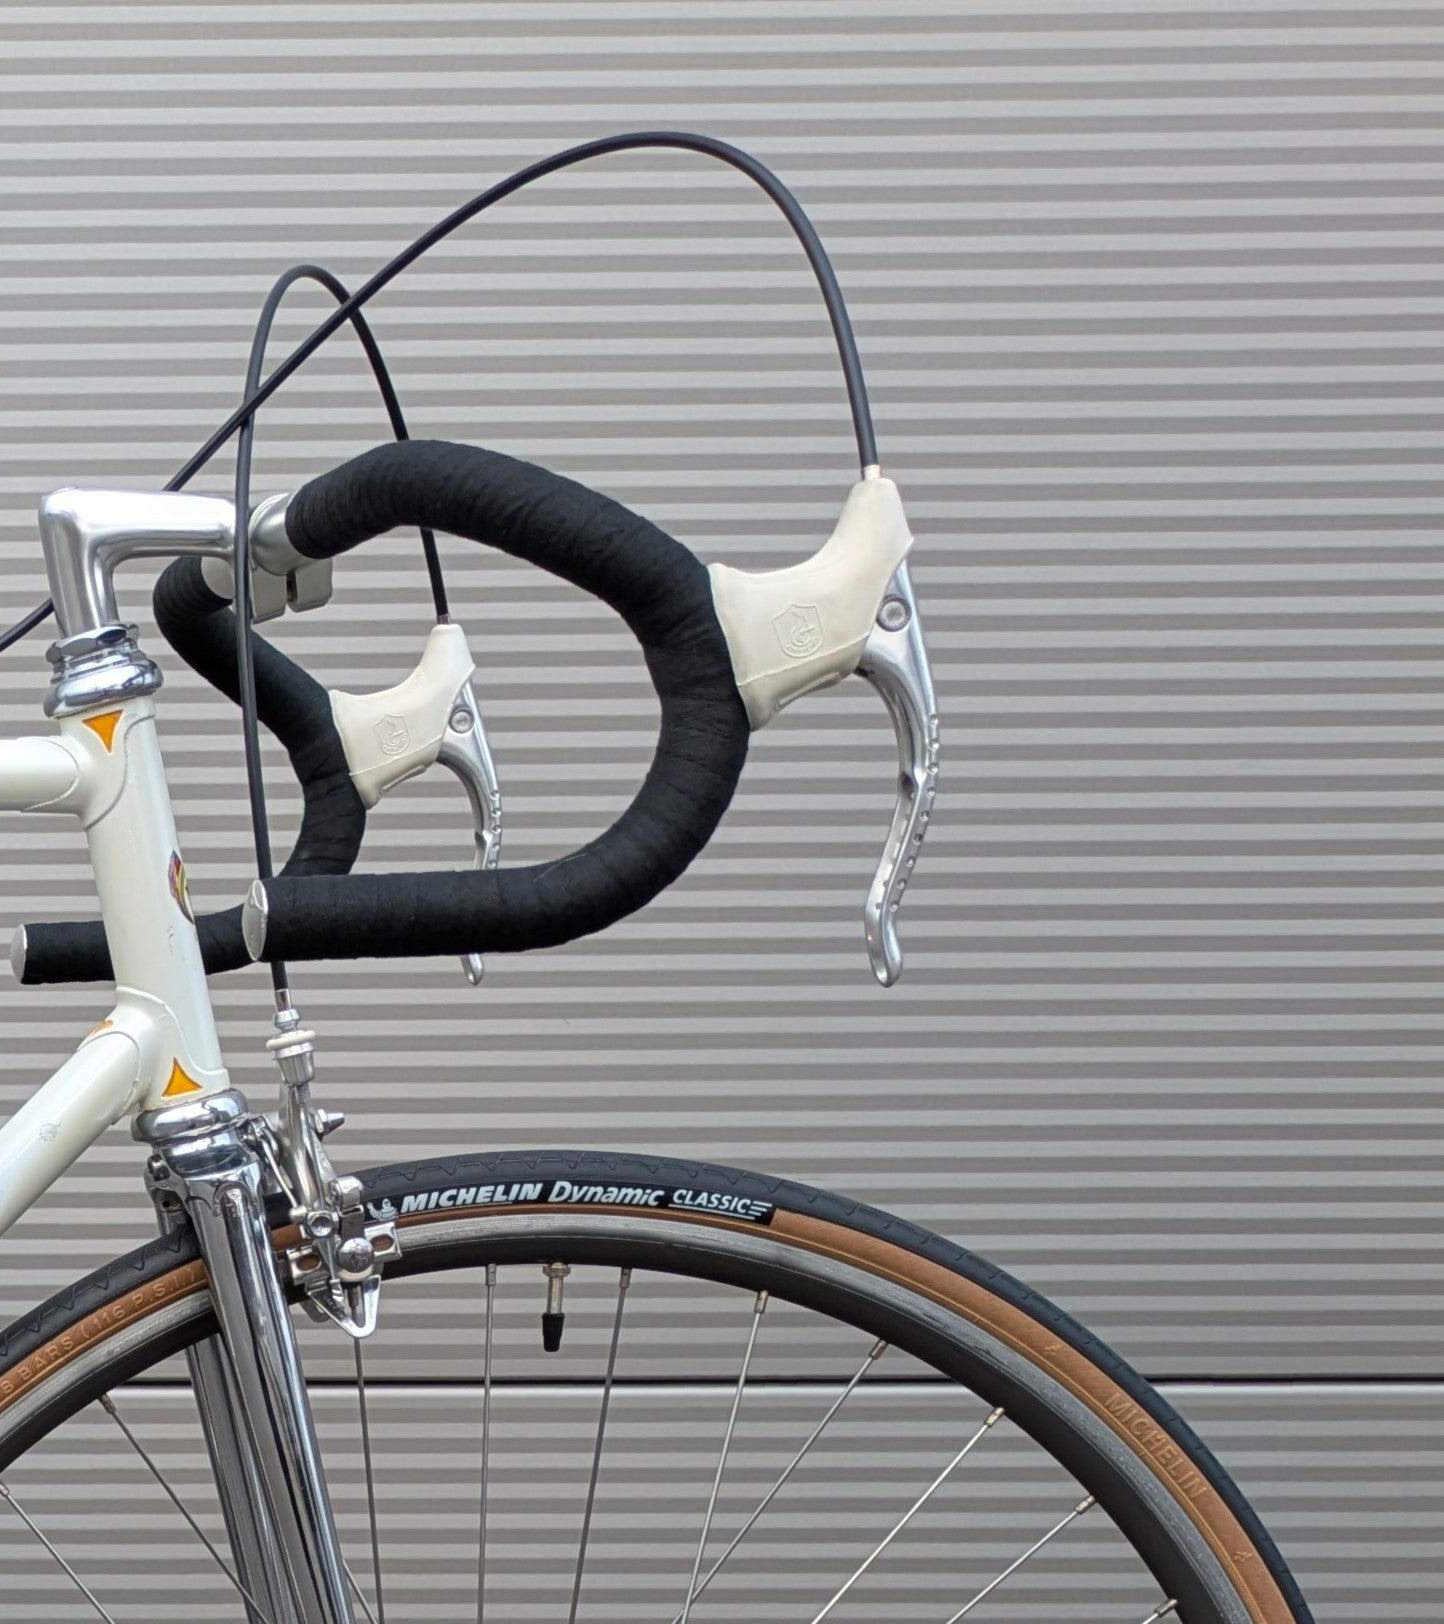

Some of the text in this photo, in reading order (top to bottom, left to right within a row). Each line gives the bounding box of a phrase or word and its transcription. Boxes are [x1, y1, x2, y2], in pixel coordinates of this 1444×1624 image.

[401, 1180, 750, 1215] MICHELIN Dynamic CLASSIC
[16, 1334, 76, 1381] BARS
[1103, 1391, 1208, 1500] MICHELIN
